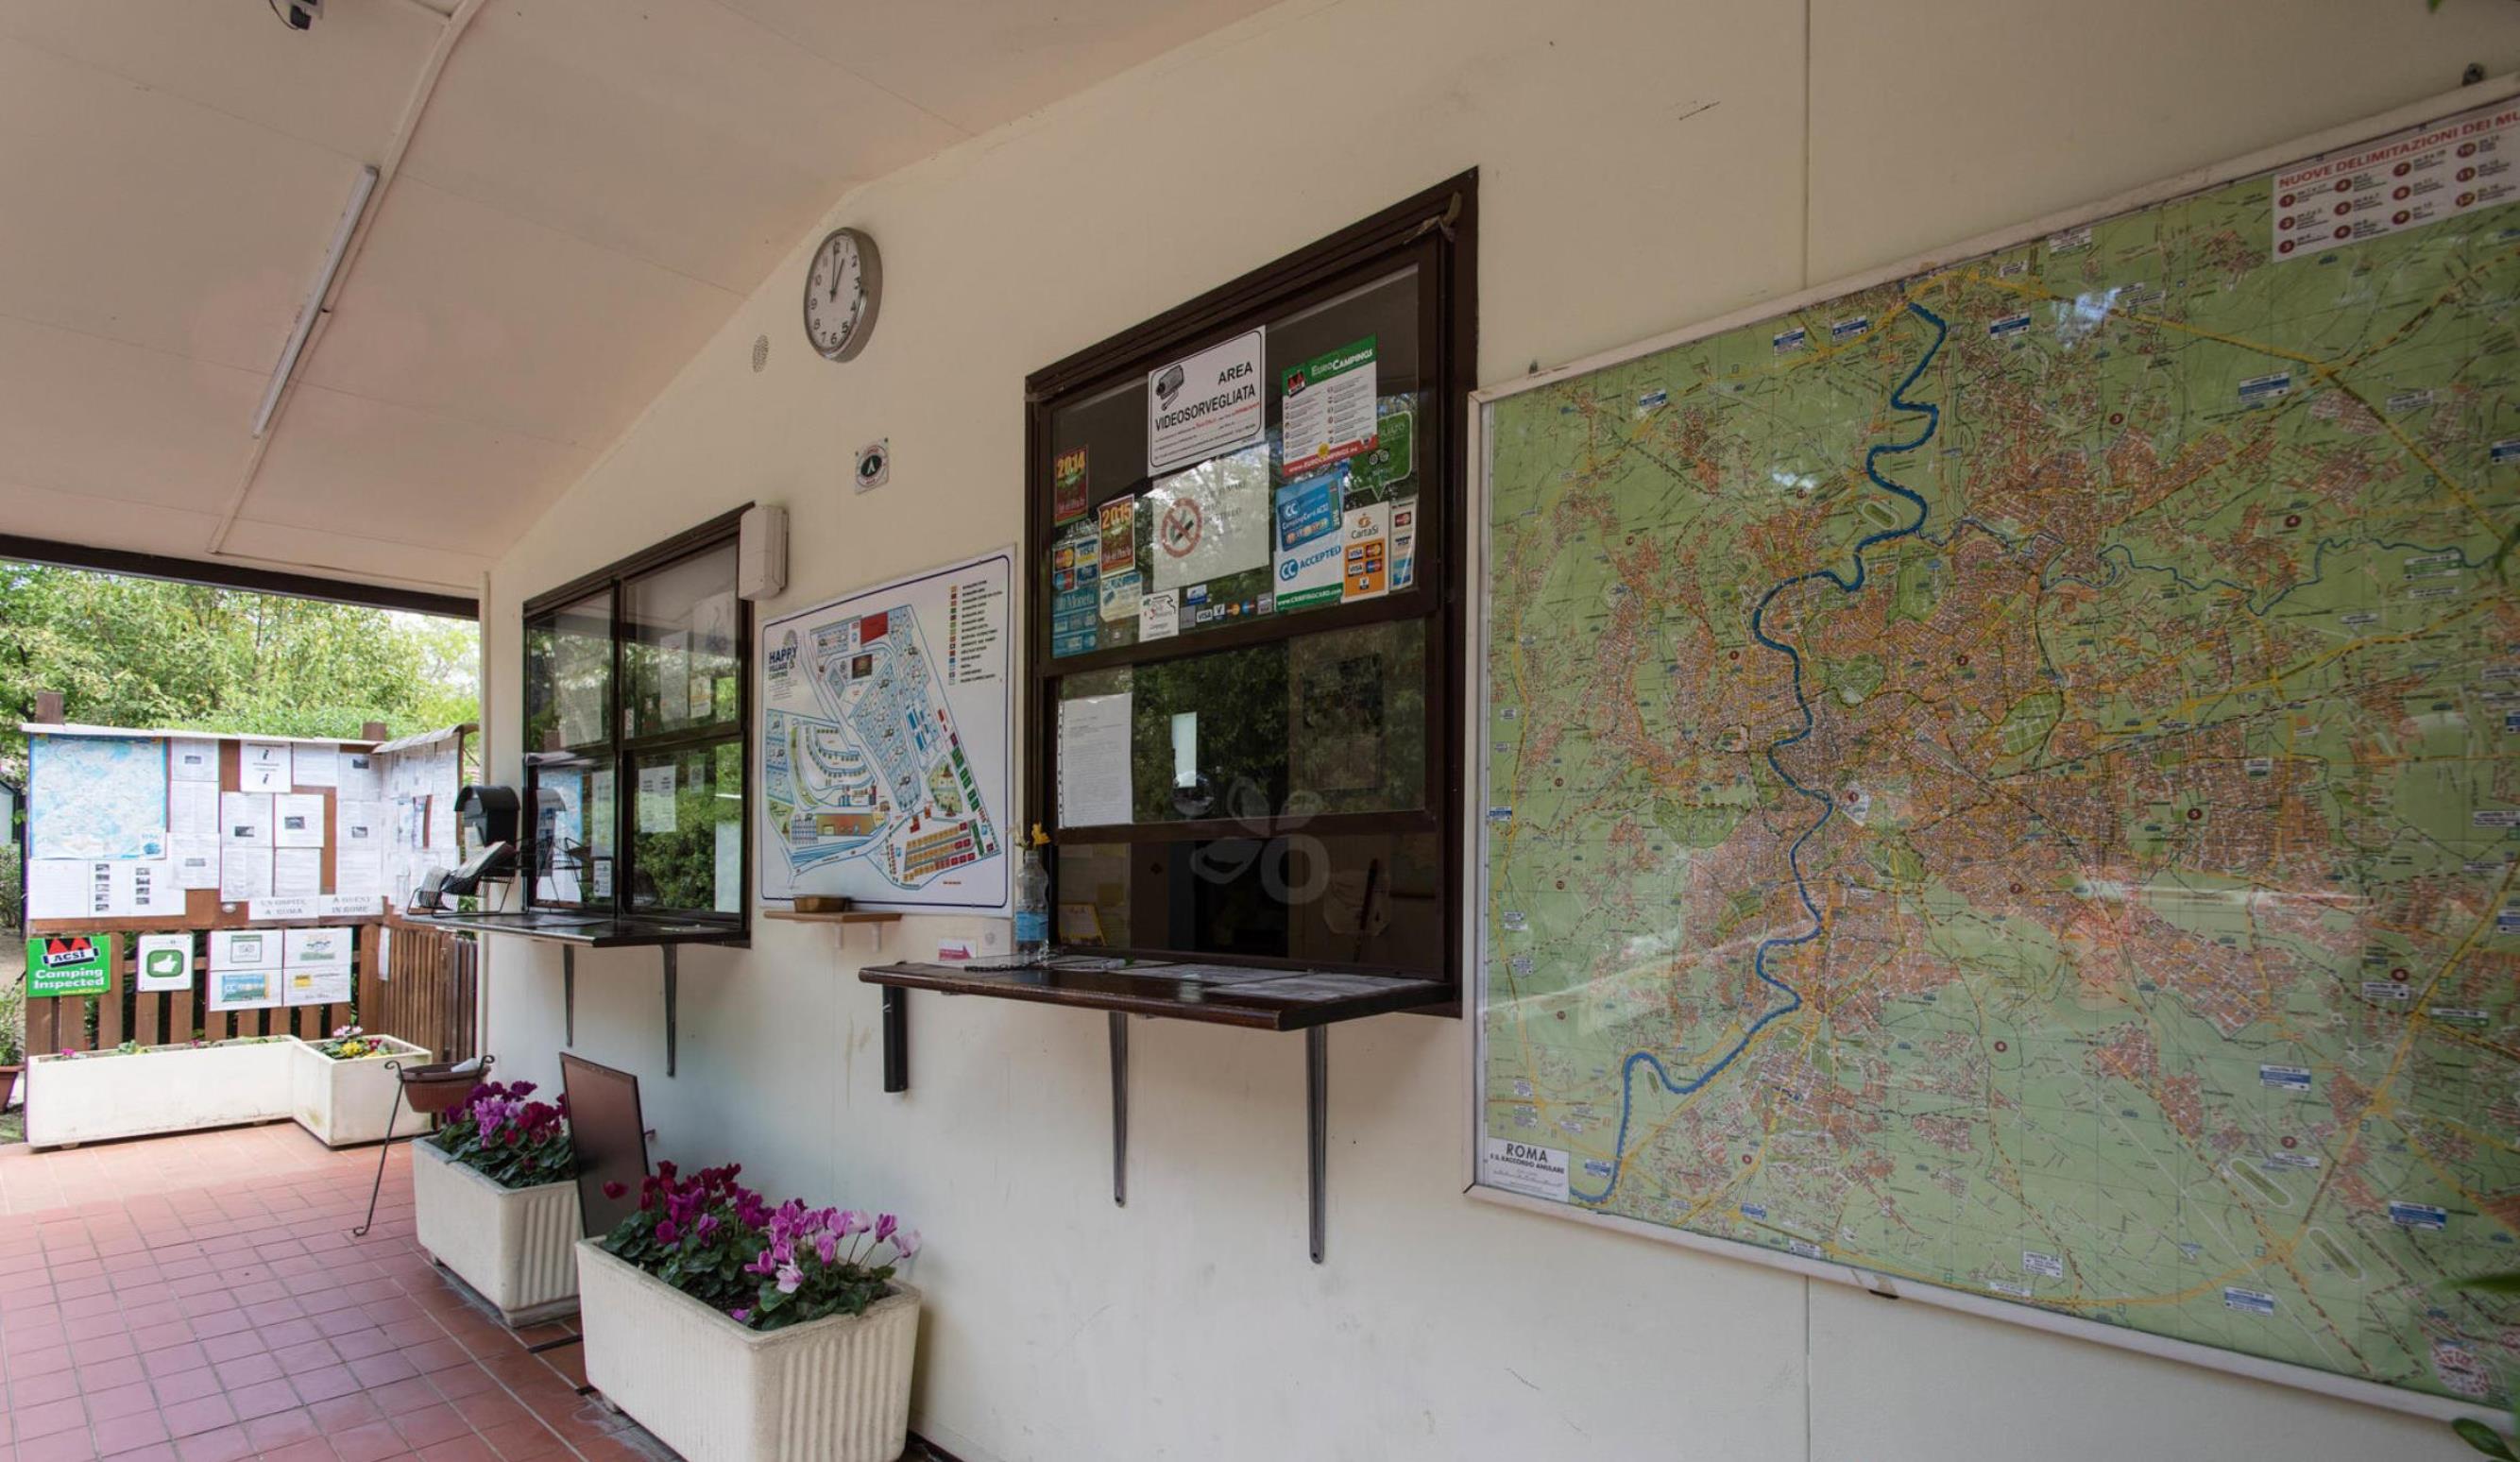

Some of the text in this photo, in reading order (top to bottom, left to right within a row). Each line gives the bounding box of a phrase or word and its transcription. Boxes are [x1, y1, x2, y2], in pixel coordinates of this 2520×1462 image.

[2278, 165, 2332, 188] NUOVE
[2336, 128, 2458, 173] DELIMITAZIONI
[2461, 119, 2491, 135] DEI
[1217, 361, 1253, 385] AREA
[1155, 383, 1256, 432] VIDEOSORVEGLIATA
[1056, 451, 1085, 479] 2014
[1101, 502, 1132, 530] 2015
[1281, 544, 1341, 580] CC ACCEPTED
[769, 645, 798, 664] HAPPY
[53, 949, 86, 962] ACSI
[34, 977, 105, 990] Inspected
[35, 968, 104, 979] Camping
[1506, 1143, 1548, 1163] ROMA
